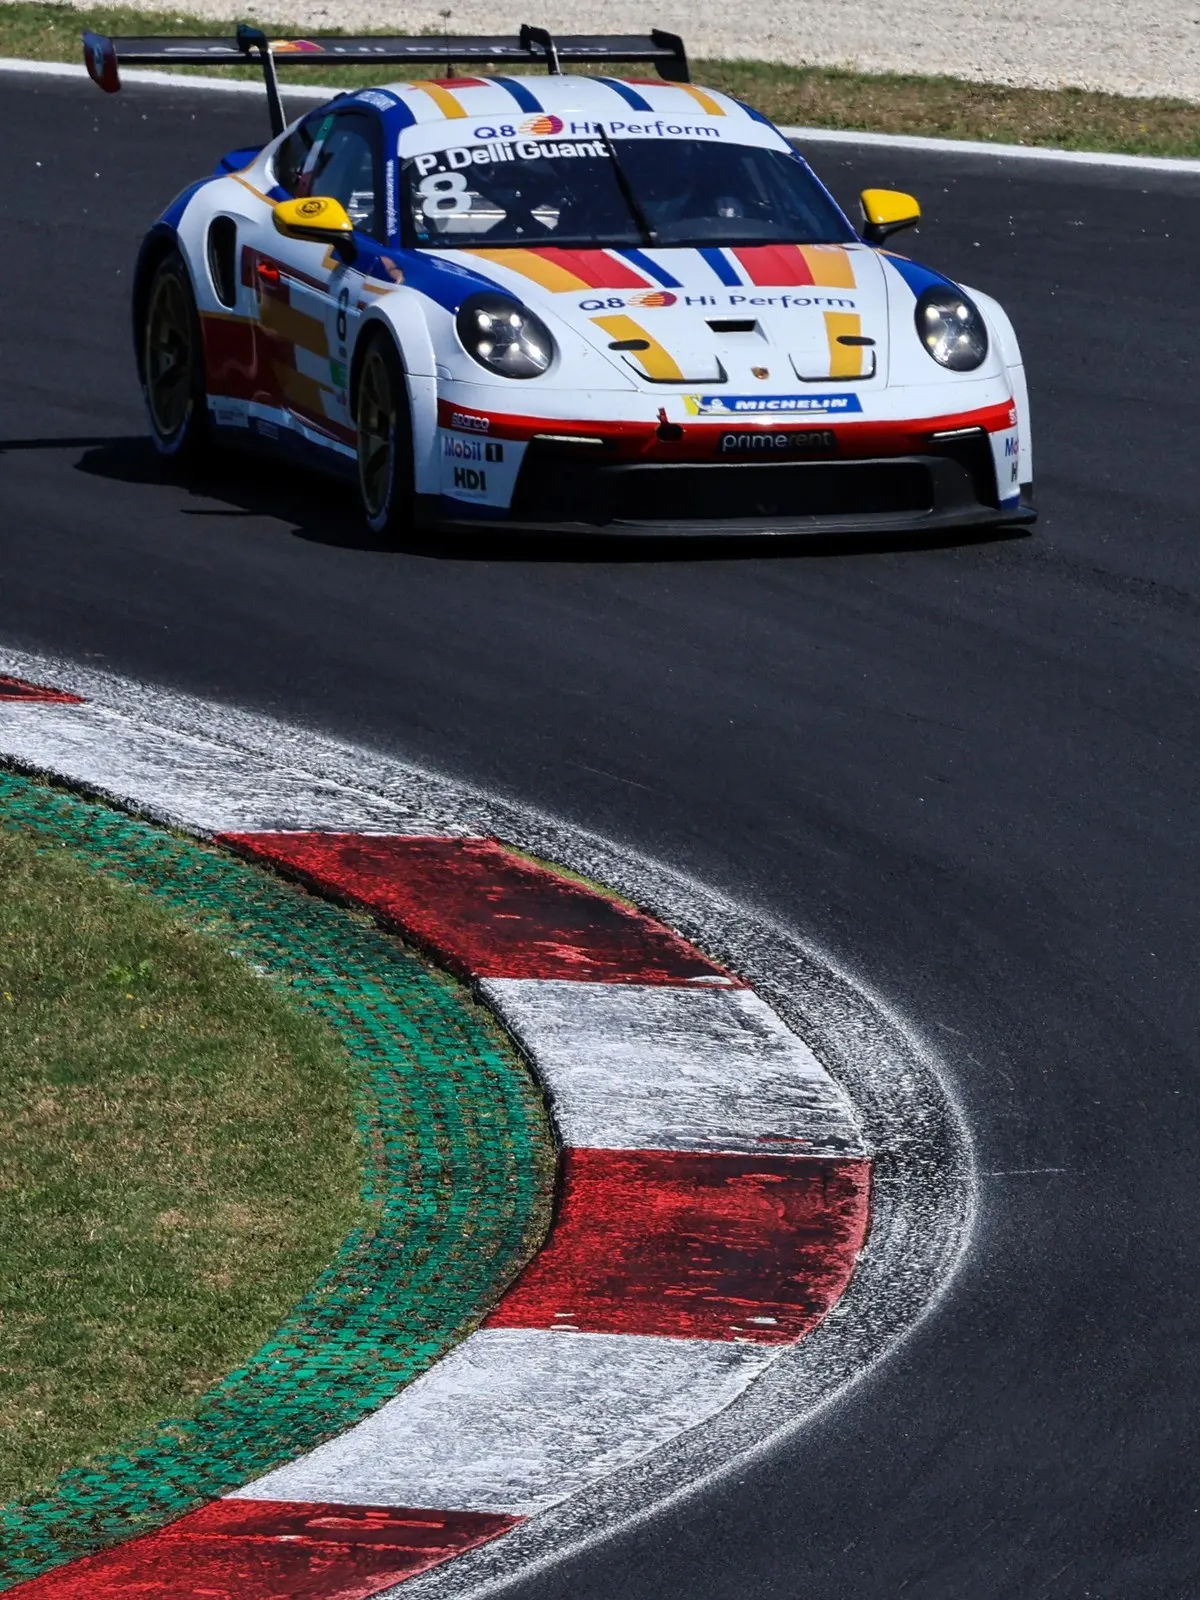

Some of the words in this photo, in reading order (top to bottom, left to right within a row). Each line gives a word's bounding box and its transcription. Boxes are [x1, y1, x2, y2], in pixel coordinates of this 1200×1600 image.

[474, 125, 516, 139] Q8
[611, 122, 720, 140] Perform
[414, 154, 446, 177] P.
[450, 144, 514, 170] Delli
[419, 172, 472, 218] 8
[579, 298, 626, 311] Q8
[684, 296, 716, 306] Hi
[730, 296, 856, 309] Perform
[735, 398, 848, 410] MICHELIN
[452, 413, 489, 430] sparco
[445, 436, 481, 461] Mobil
[722, 430, 833, 452] primerent
[454, 467, 486, 491] HDI
